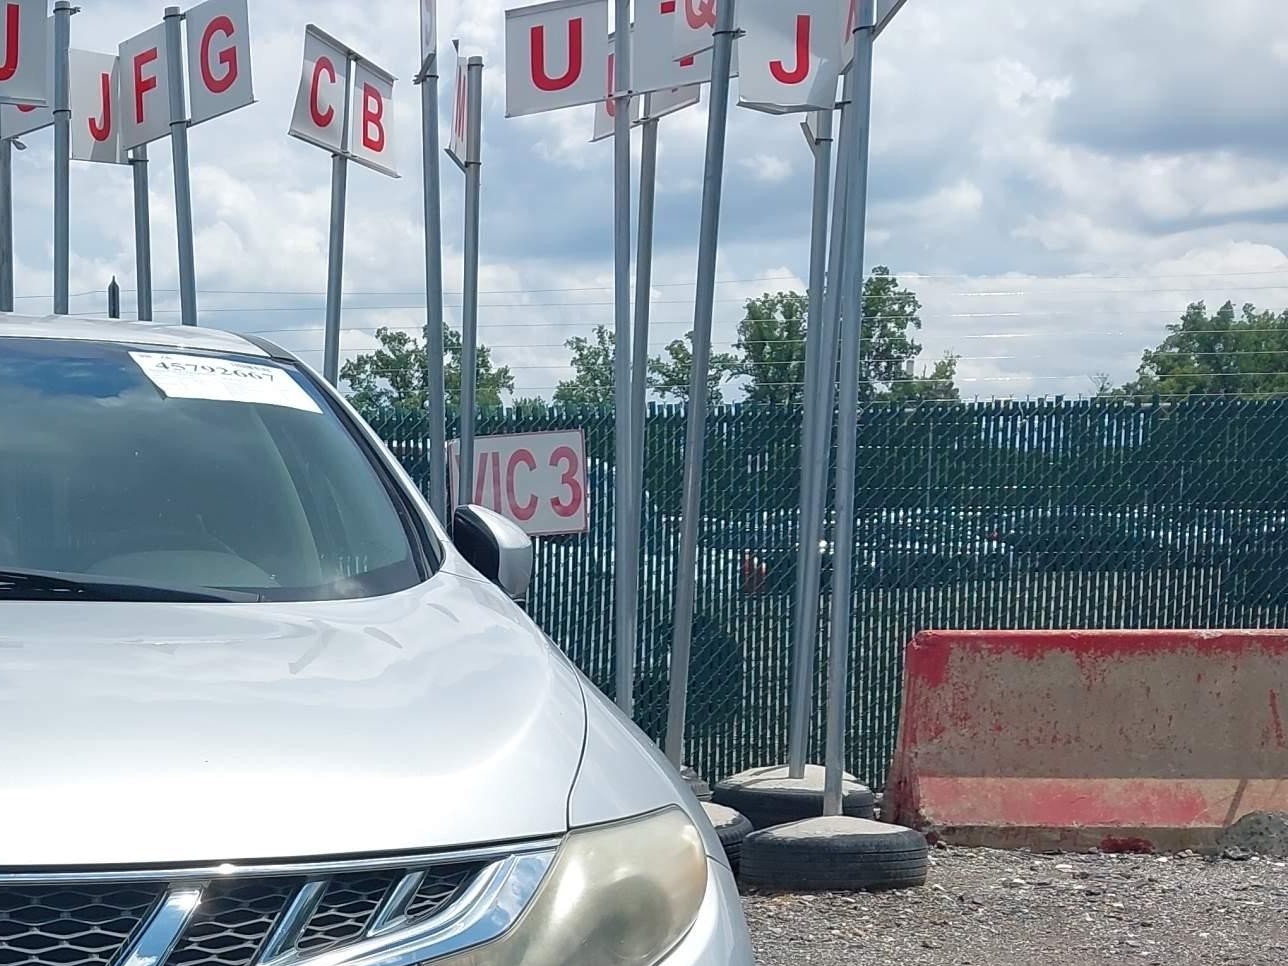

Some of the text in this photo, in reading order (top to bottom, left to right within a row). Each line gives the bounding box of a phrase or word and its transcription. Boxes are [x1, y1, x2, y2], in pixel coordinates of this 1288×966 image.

[200, 15, 238, 94] G
[530, 17, 582, 91] U
[770, 14, 810, 84] J
[88, 73, 111, 141] J
[134, 47, 157, 124] F
[310, 56, 336, 128] C
[363, 81, 385, 152] B
[154, 361, 275, 382] 45792667
[549, 446, 582, 517] 3
